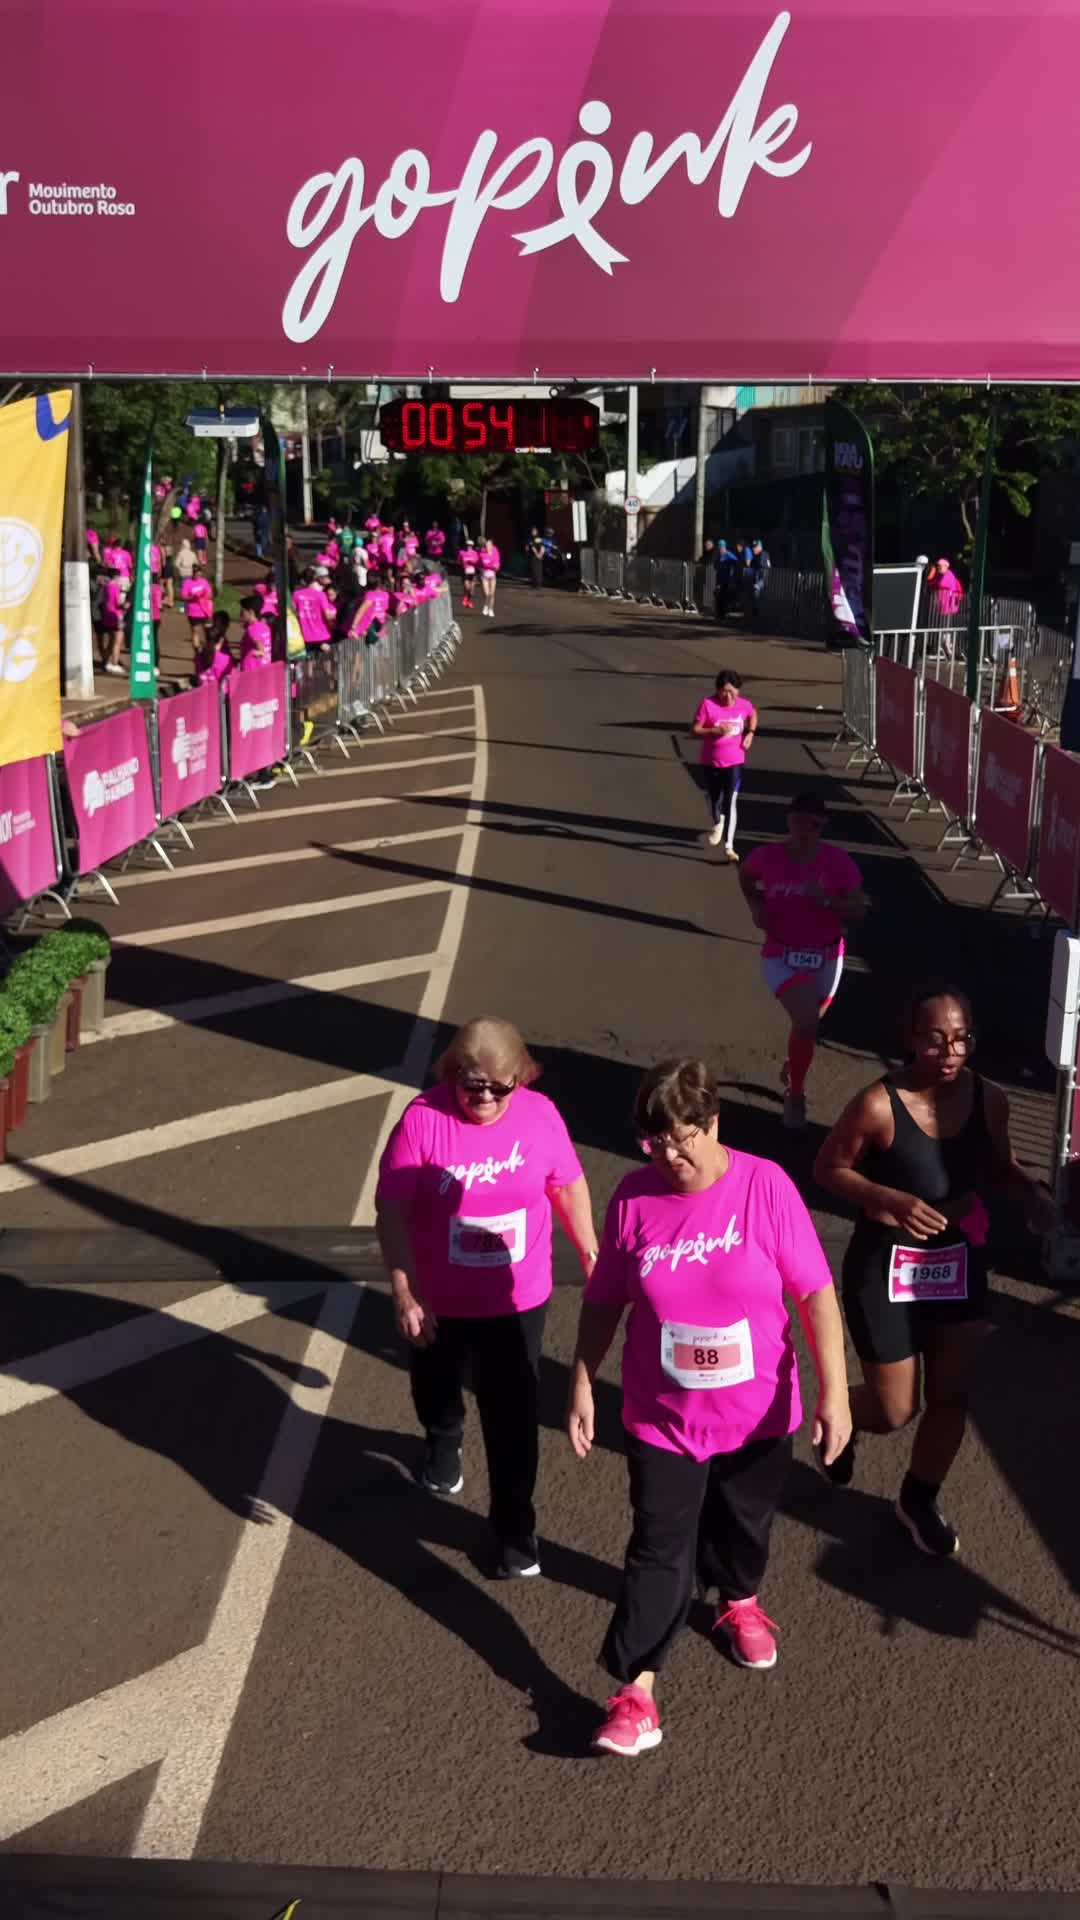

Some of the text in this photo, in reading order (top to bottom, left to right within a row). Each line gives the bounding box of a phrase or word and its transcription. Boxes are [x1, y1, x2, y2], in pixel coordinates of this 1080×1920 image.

[282, 10, 812, 343] gopink
[29, 182, 117, 199] Movimento
[29, 199, 136, 215] Outubro Rosa
[440, 1140, 525, 1195] gopink
[640, 1214, 743, 1277] gopink
[910, 1265, 952, 1279] 1968
[693, 1348, 719, 1366] 88
